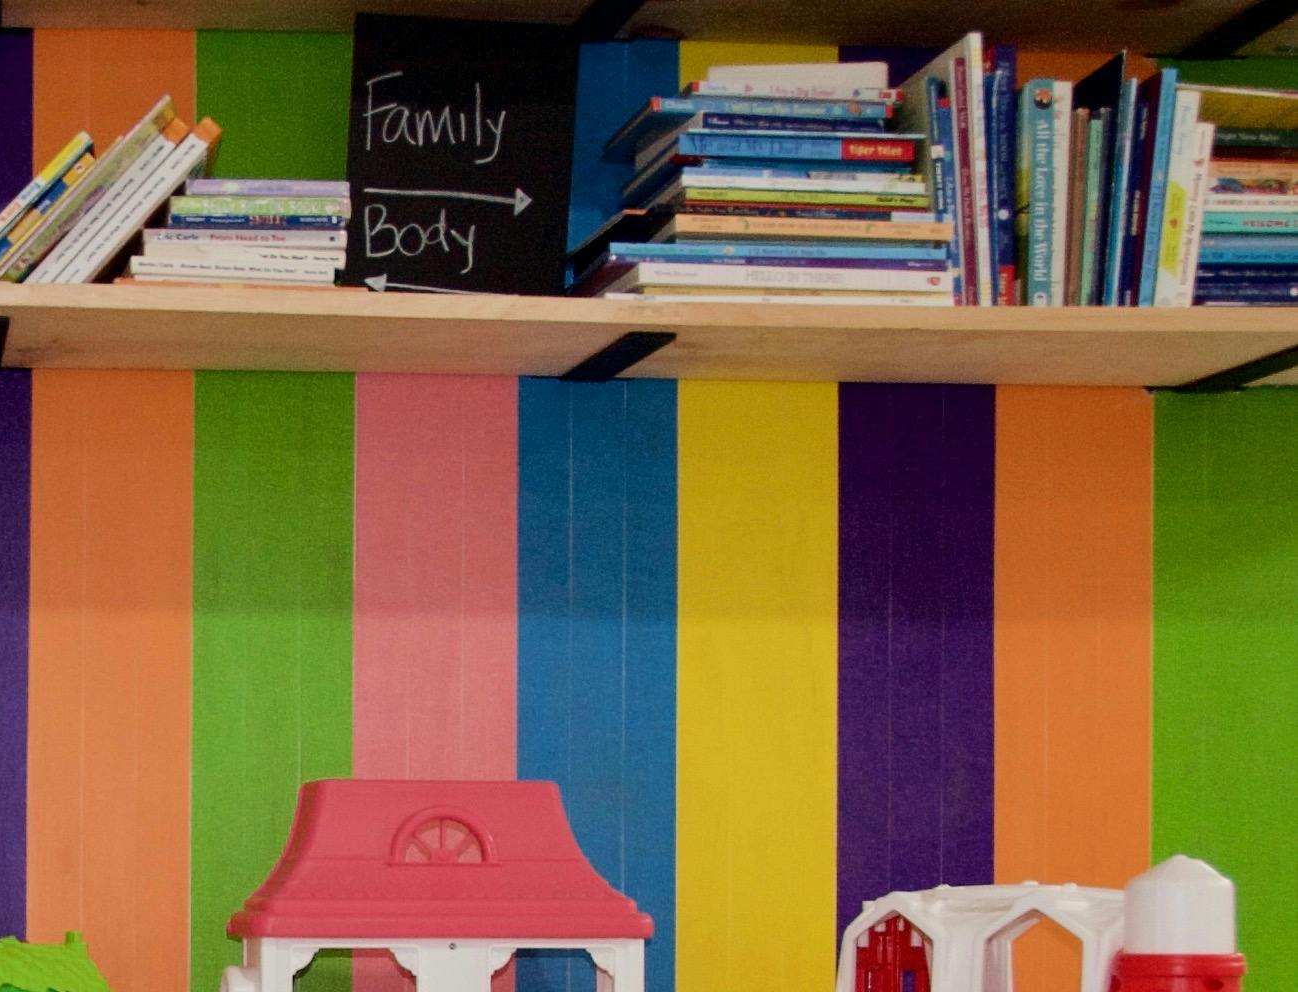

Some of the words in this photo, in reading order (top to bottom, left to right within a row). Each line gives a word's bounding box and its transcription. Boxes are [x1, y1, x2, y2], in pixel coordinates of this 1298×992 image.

[363, 71, 506, 165] Family
[1036, 120, 1050, 137] All
[1035, 143, 1049, 164] the
[1033, 167, 1049, 199] Love
[1033, 202, 1048, 216] in
[1033, 218, 1048, 240] the
[1032, 241, 1048, 282] World
